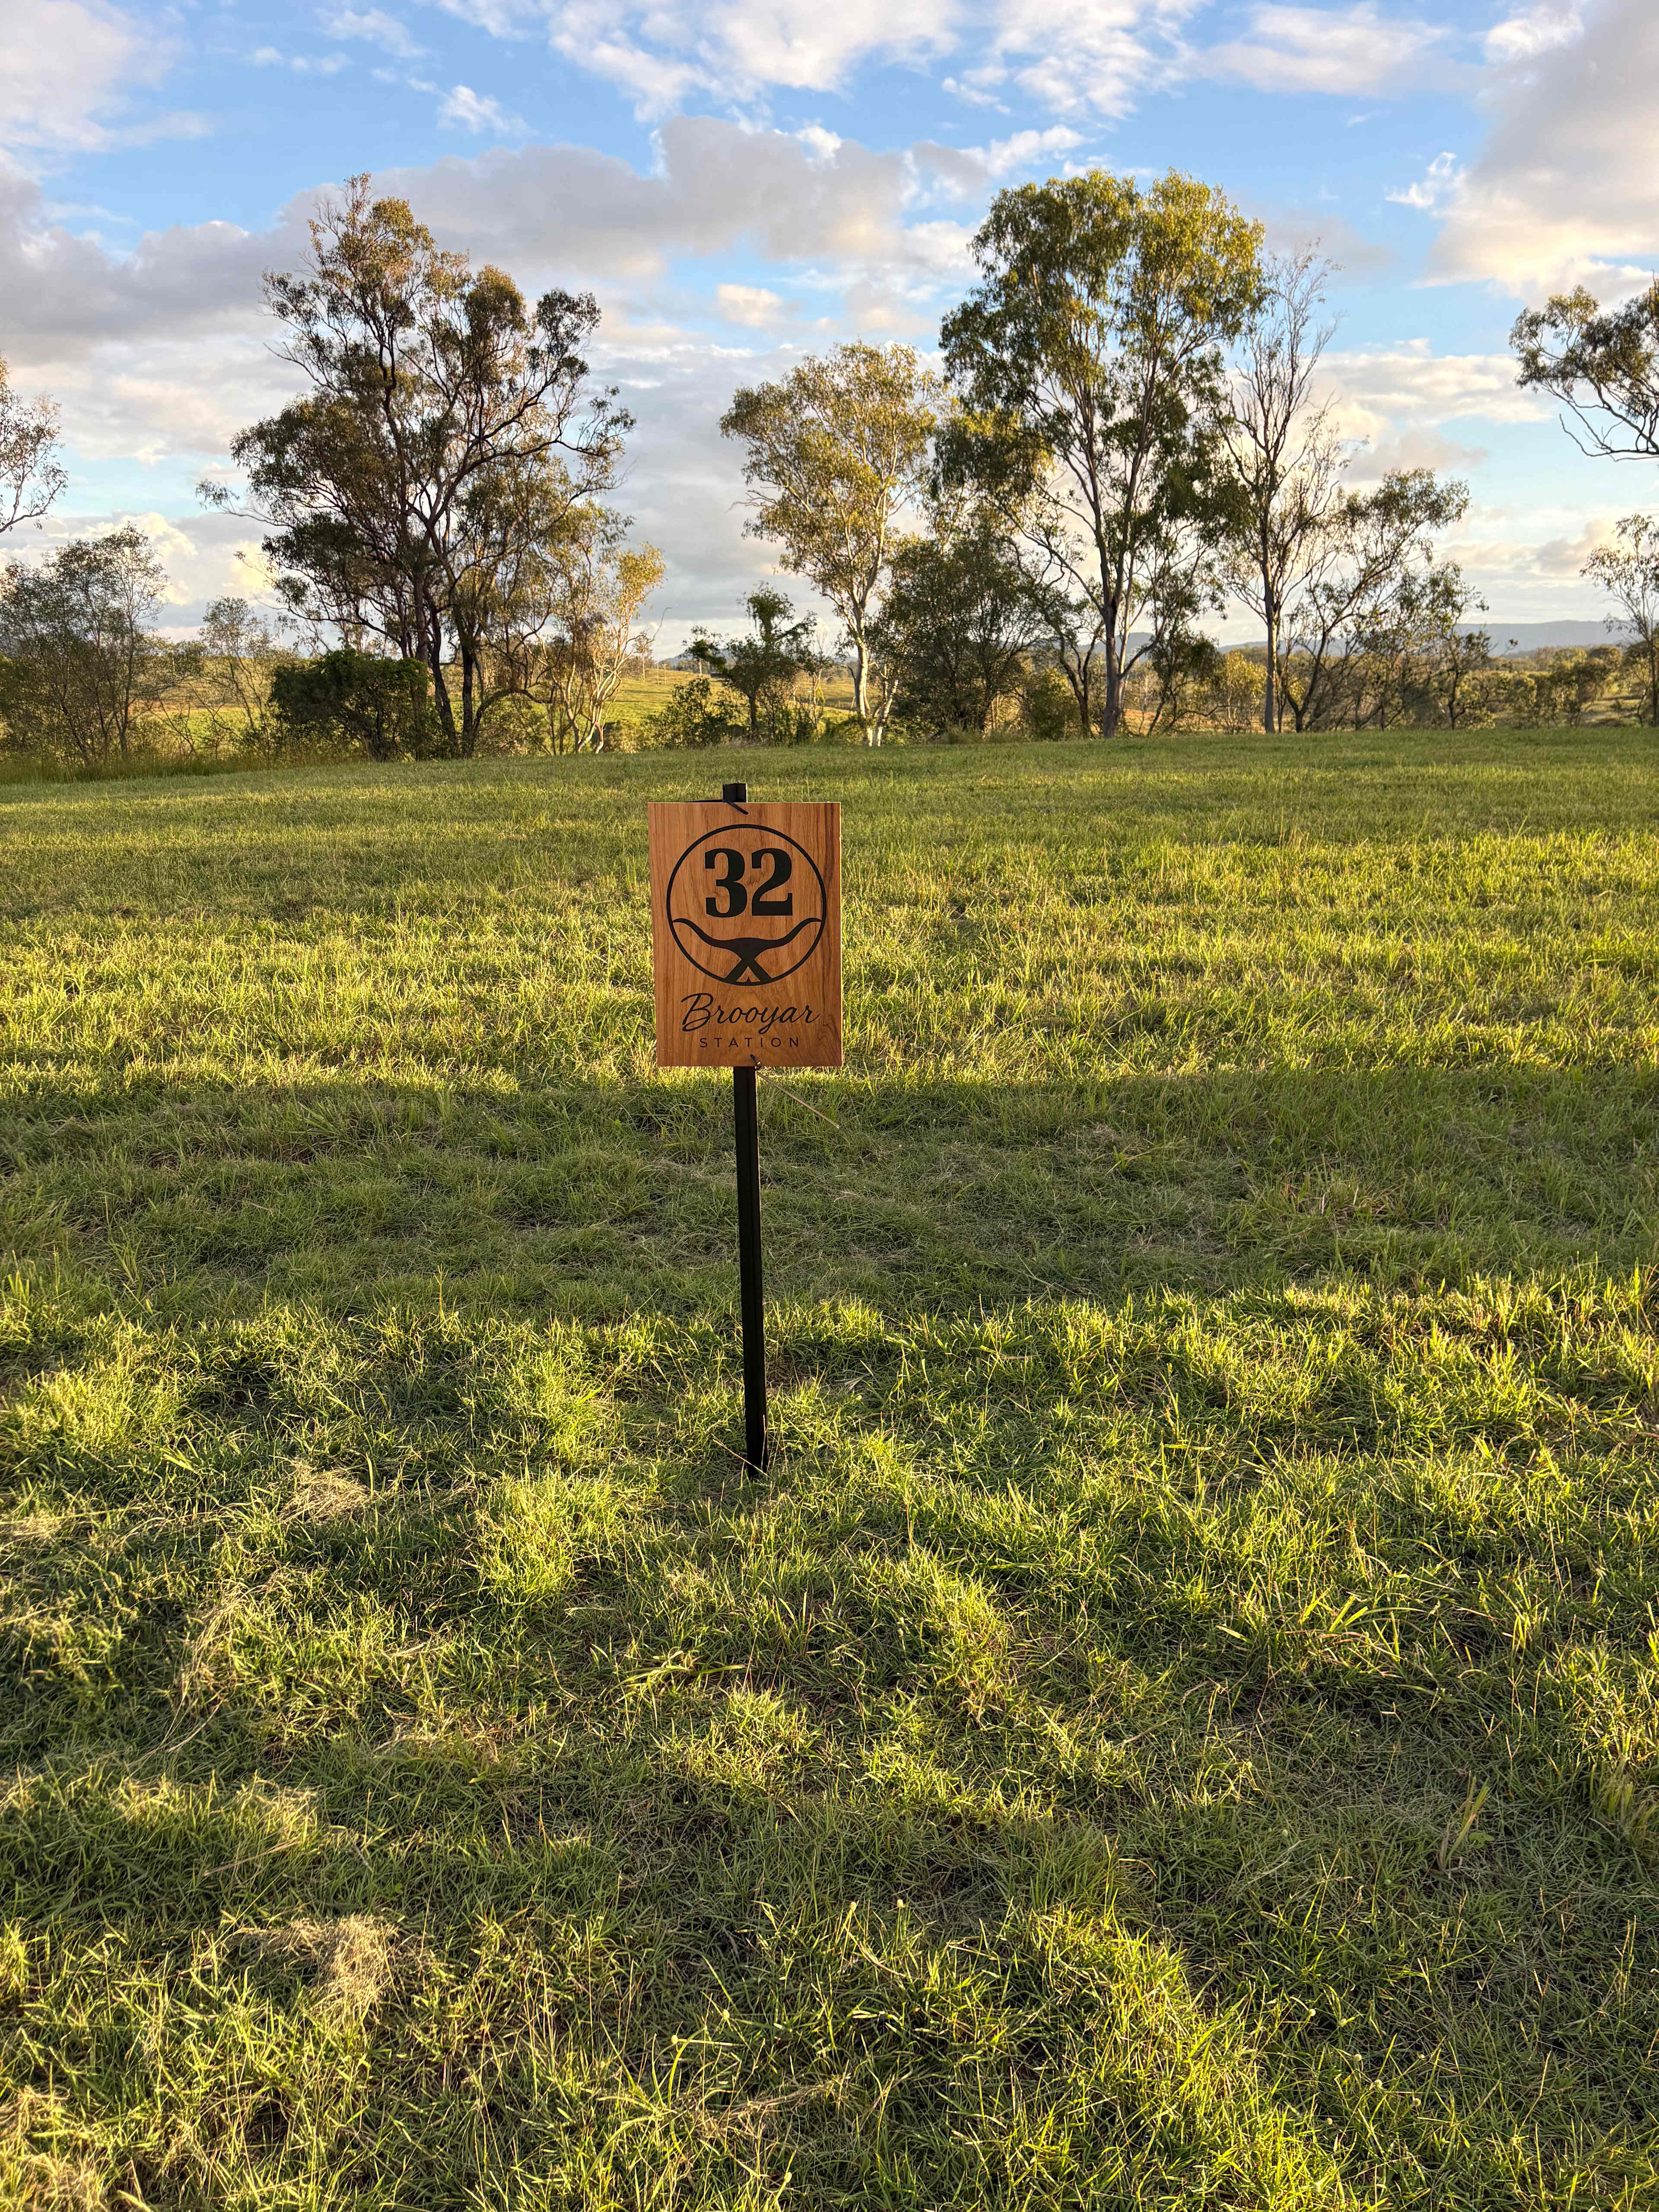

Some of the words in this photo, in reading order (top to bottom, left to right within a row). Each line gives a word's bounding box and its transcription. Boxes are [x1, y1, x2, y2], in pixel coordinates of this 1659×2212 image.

[704, 848, 793, 918] 32
[680, 993, 820, 1035] Brooyar
[699, 1037, 799, 1048] STATION
